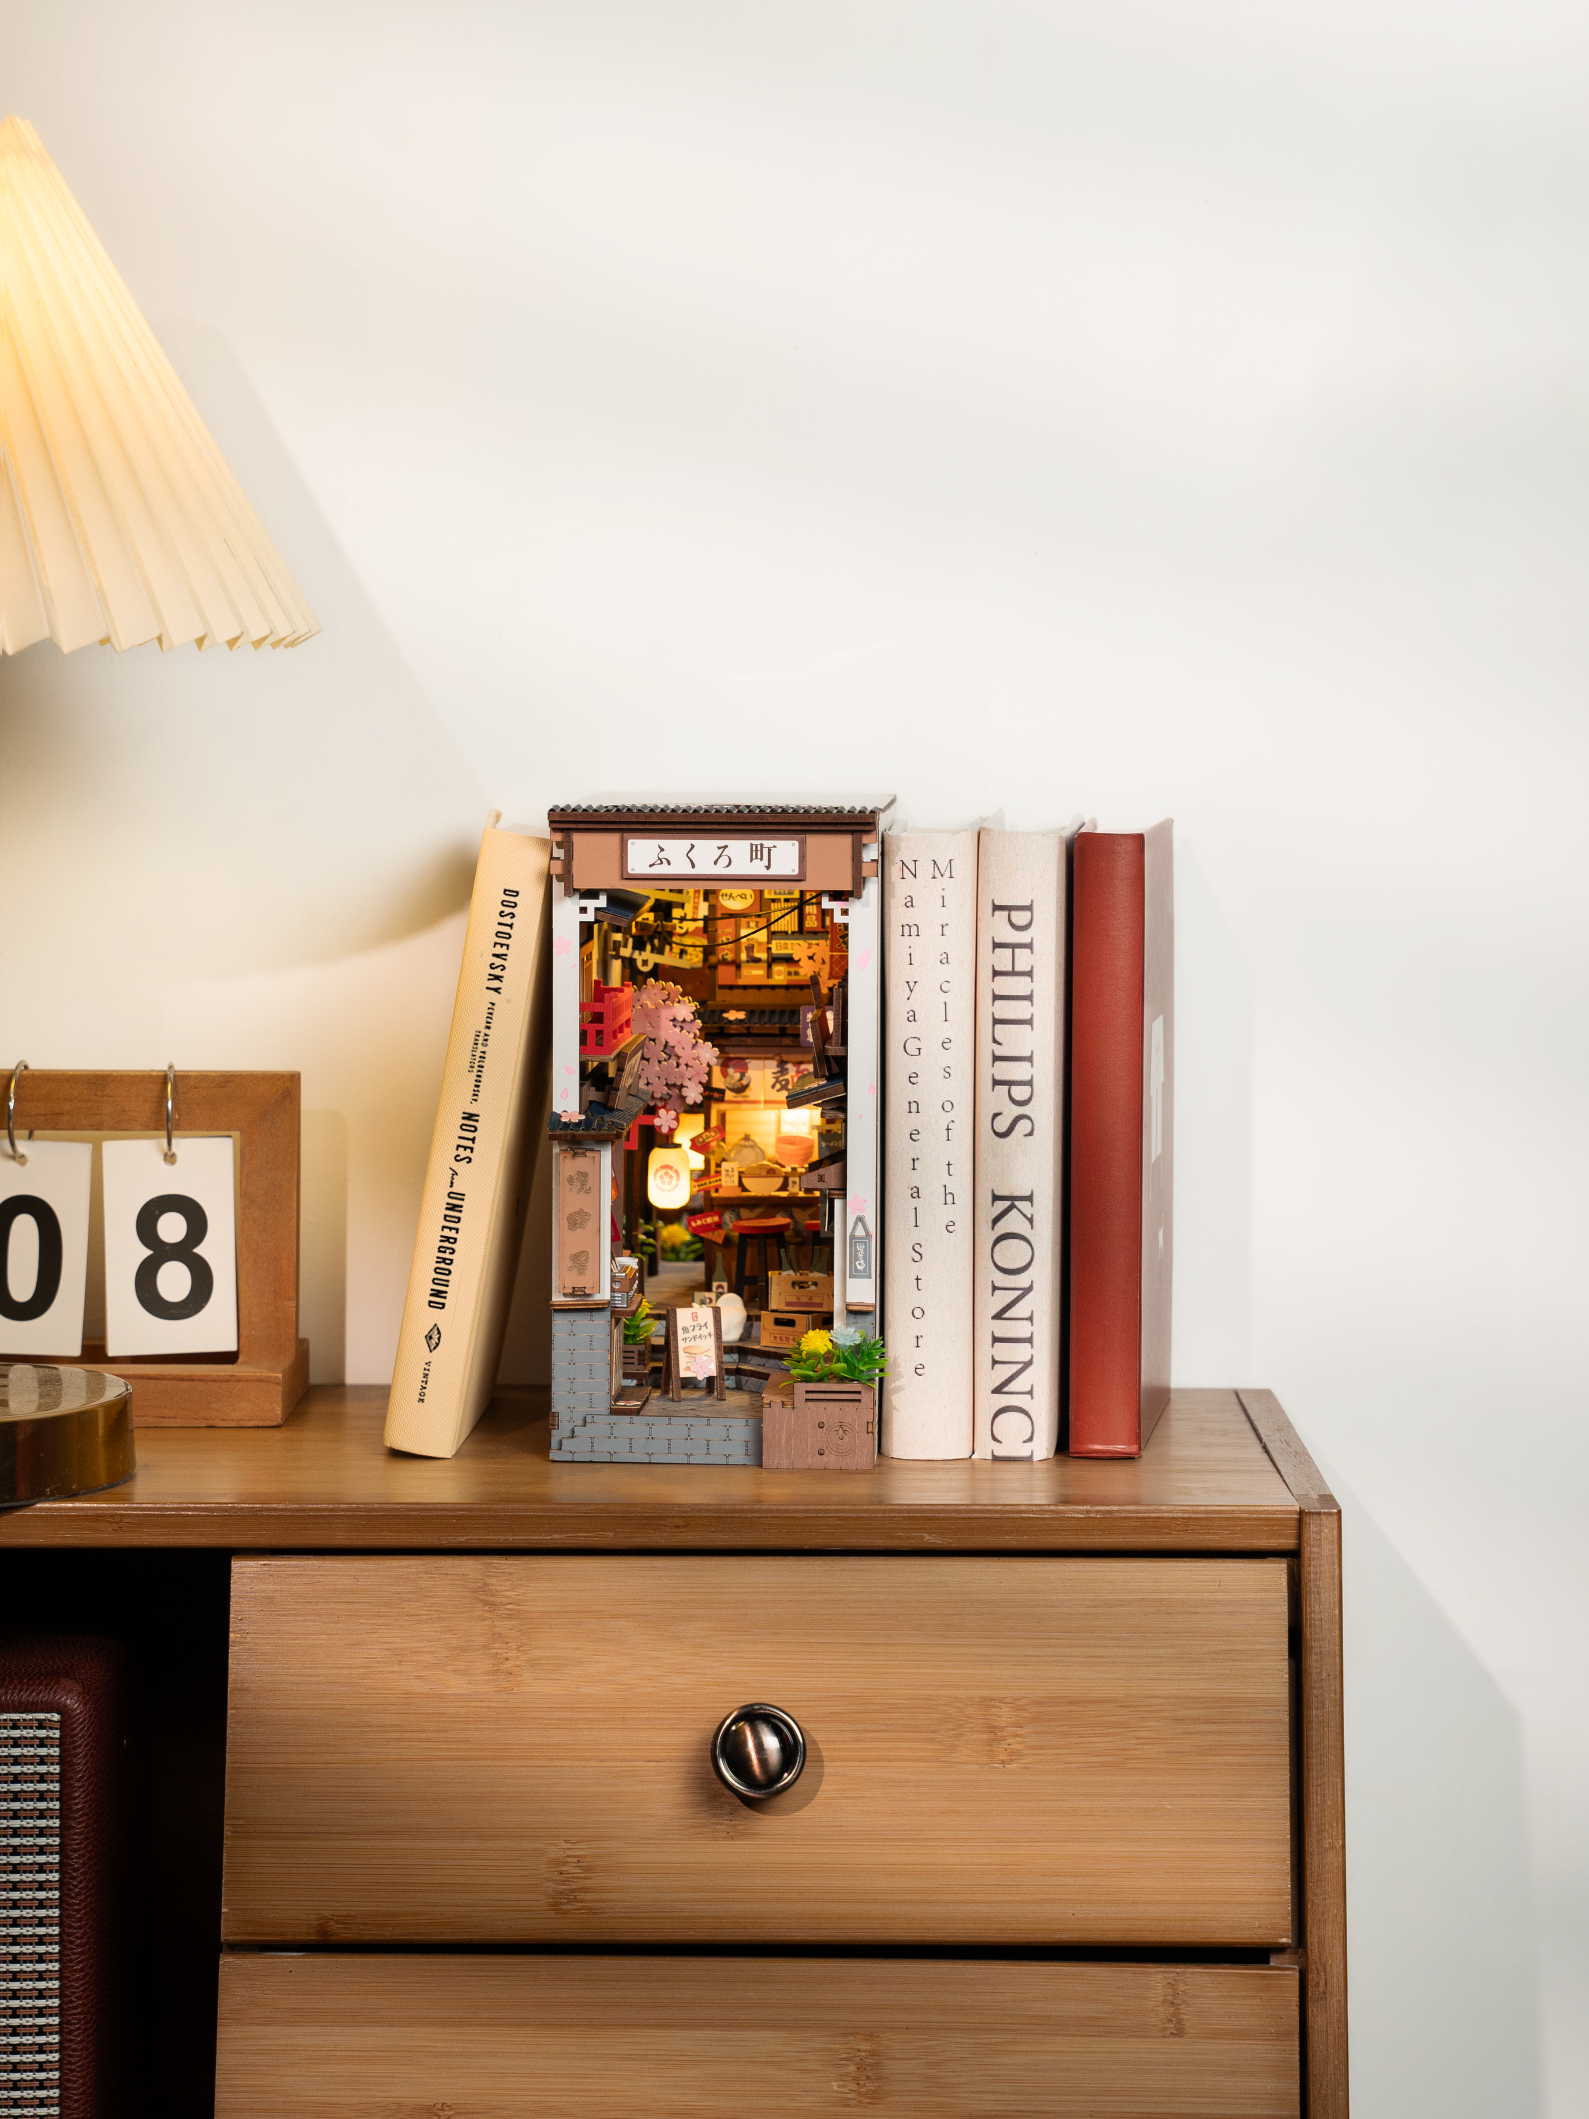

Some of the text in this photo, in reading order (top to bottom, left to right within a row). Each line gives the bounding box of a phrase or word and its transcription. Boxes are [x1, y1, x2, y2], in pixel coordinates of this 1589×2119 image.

[648, 842, 778, 871] ふくろ町
[721, 892, 753, 902] せんべい
[485, 887, 520, 996] DOSTOEVSKY
[483, 1001, 496, 1031] PEVEAR
[990, 898, 1036, 1140] PHILIPS
[467, 1029, 482, 1074] TRANSLATORS
[480, 1031, 491, 1048] AND
[453, 1111, 481, 1165] NOTES
[134, 1193, 215, 1321] 8
[427, 1190, 468, 1311] UNDERGROUND
[681, 1321, 709, 1335] 魚フライ
[681, 1331, 714, 1344] サンドイッチ
[417, 1360, 432, 1404] VINTAGE
